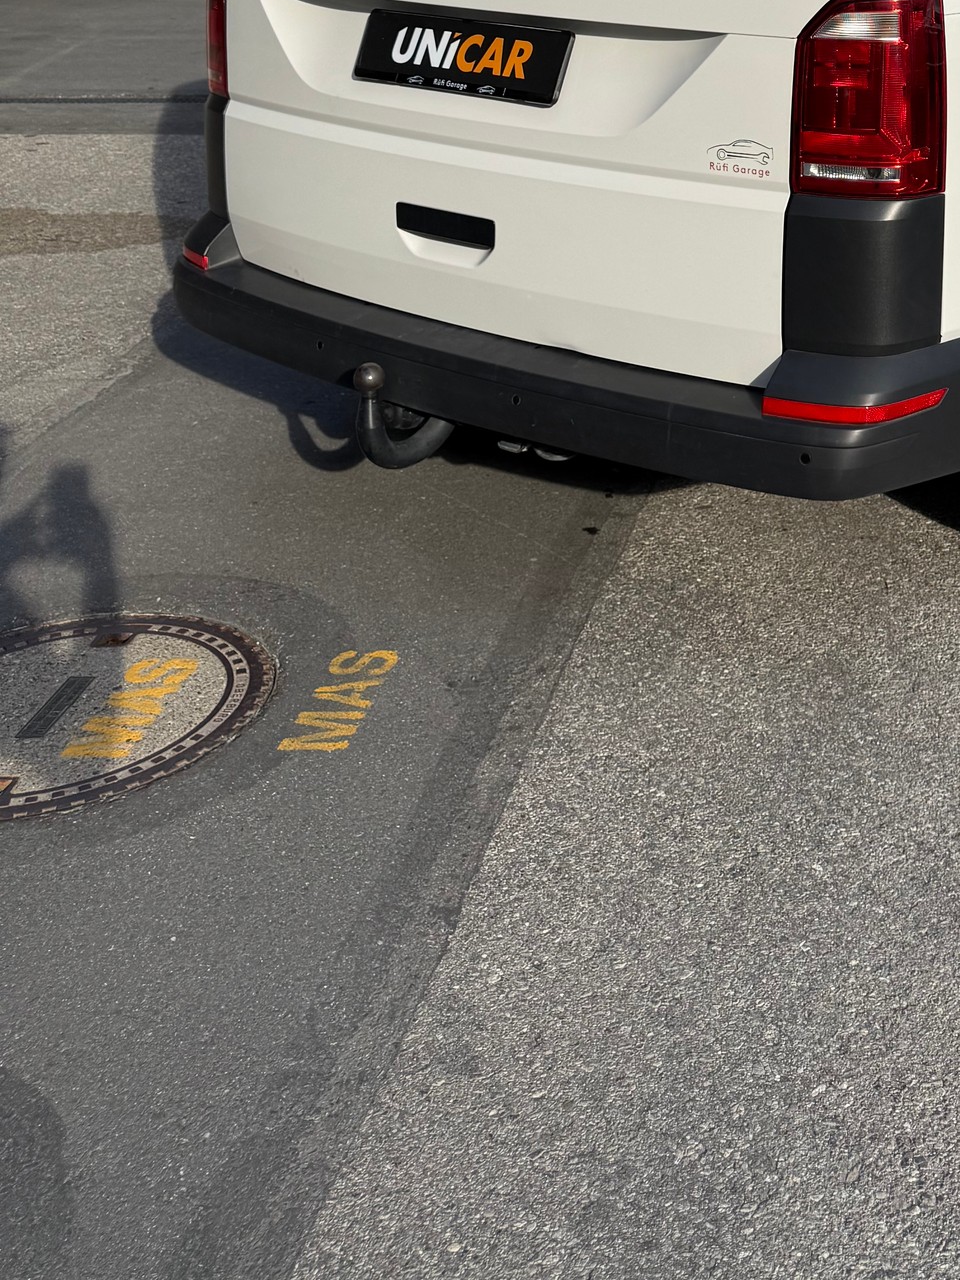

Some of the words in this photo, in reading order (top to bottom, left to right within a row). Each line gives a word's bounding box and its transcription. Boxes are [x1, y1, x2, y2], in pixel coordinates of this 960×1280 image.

[446, 79, 468, 91] Garage
[709, 161, 729, 172] Rüfi
[732, 164, 770, 178] Garage
[277, 650, 399, 752] MAS
